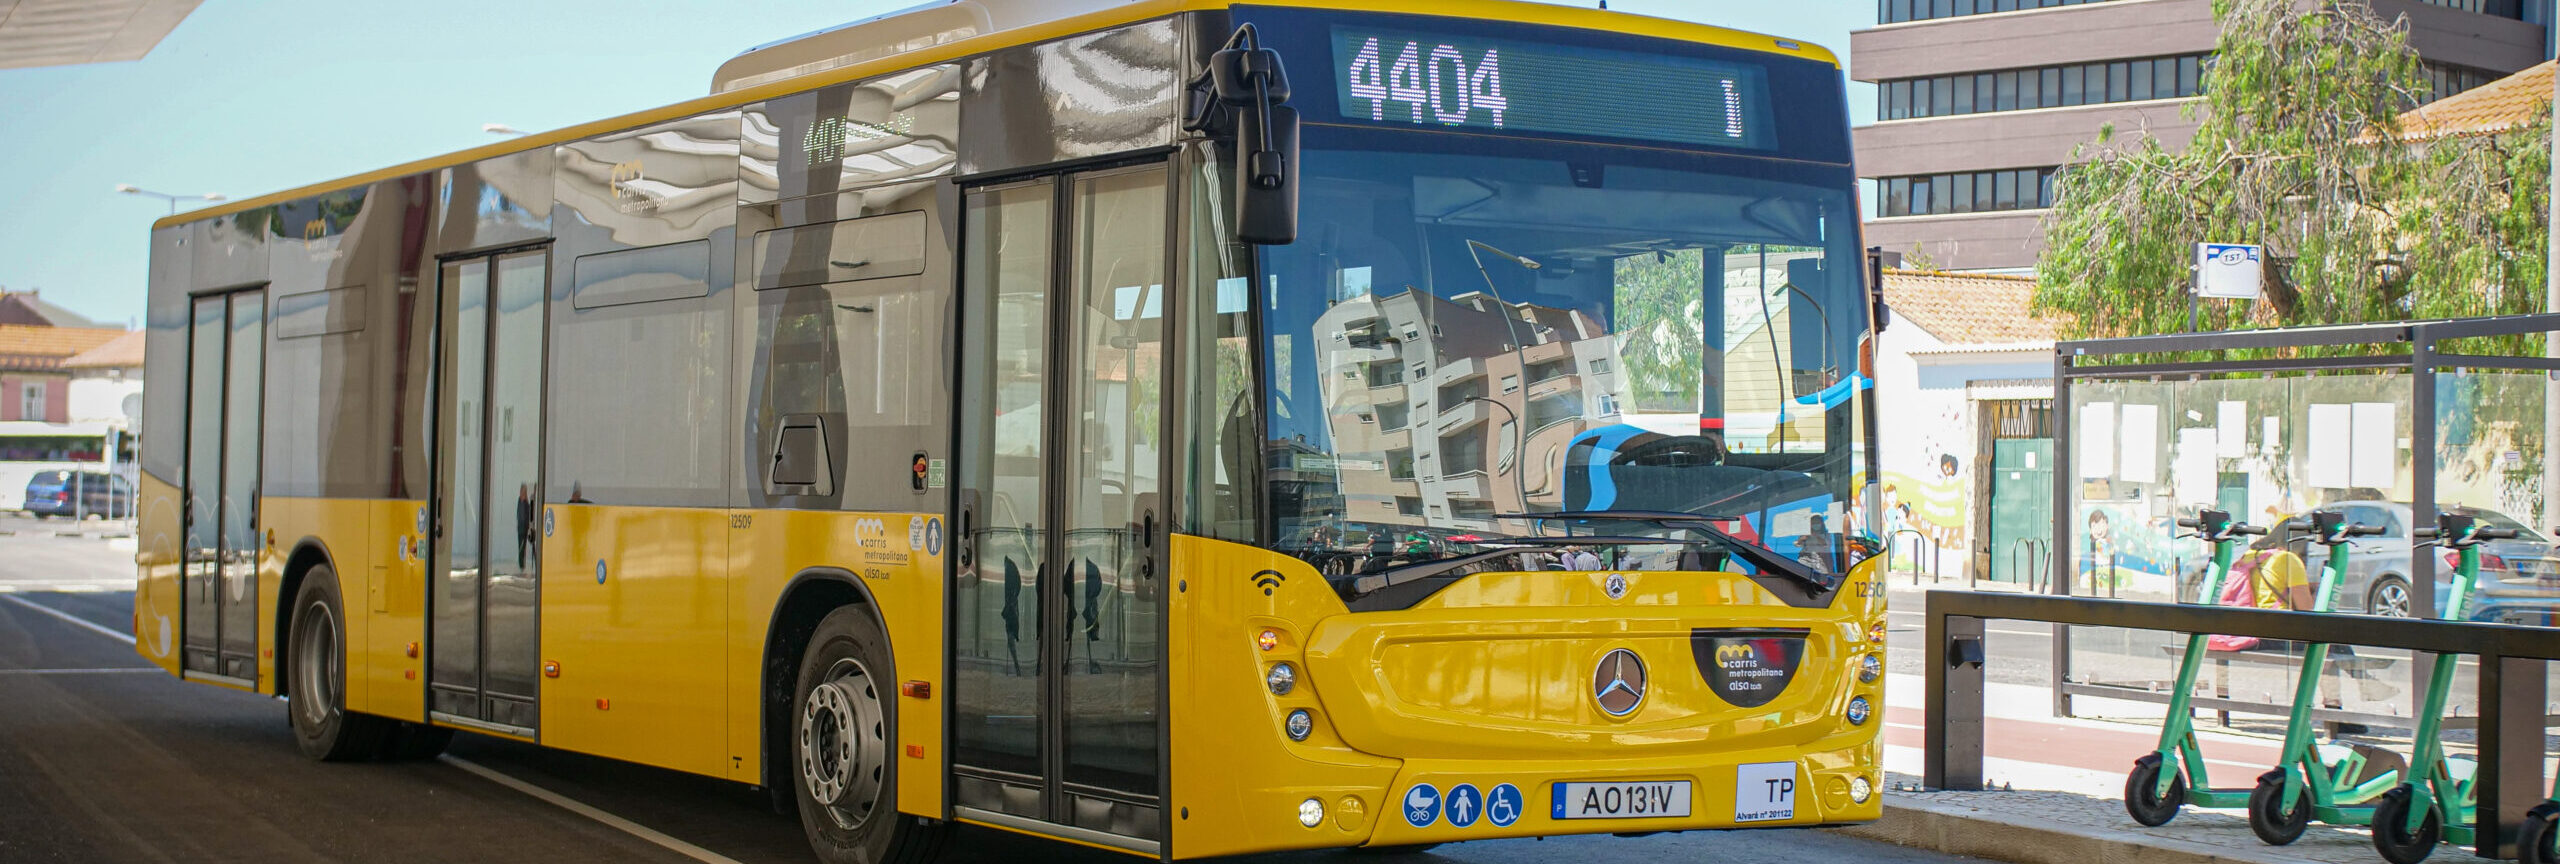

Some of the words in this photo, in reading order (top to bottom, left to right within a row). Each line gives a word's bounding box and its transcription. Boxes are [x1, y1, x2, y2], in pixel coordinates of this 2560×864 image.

[1350, 37, 1507, 129] 4404
[803, 116, 846, 165] 4404
[2224, 253, 2240, 262] TST
[731, 514, 752, 529] 12509
[864, 538, 887, 548] carris
[864, 551, 908, 562] metropolitana
[864, 566, 880, 579] alsa
[1729, 660, 1758, 669] carris
[1729, 668, 1784, 679] metropolitana
[1729, 680, 1750, 691] alsa
[1765, 778, 1794, 803] TP
[1556, 804, 1563, 813] P
[1769, 810, 1792, 818] 201122
